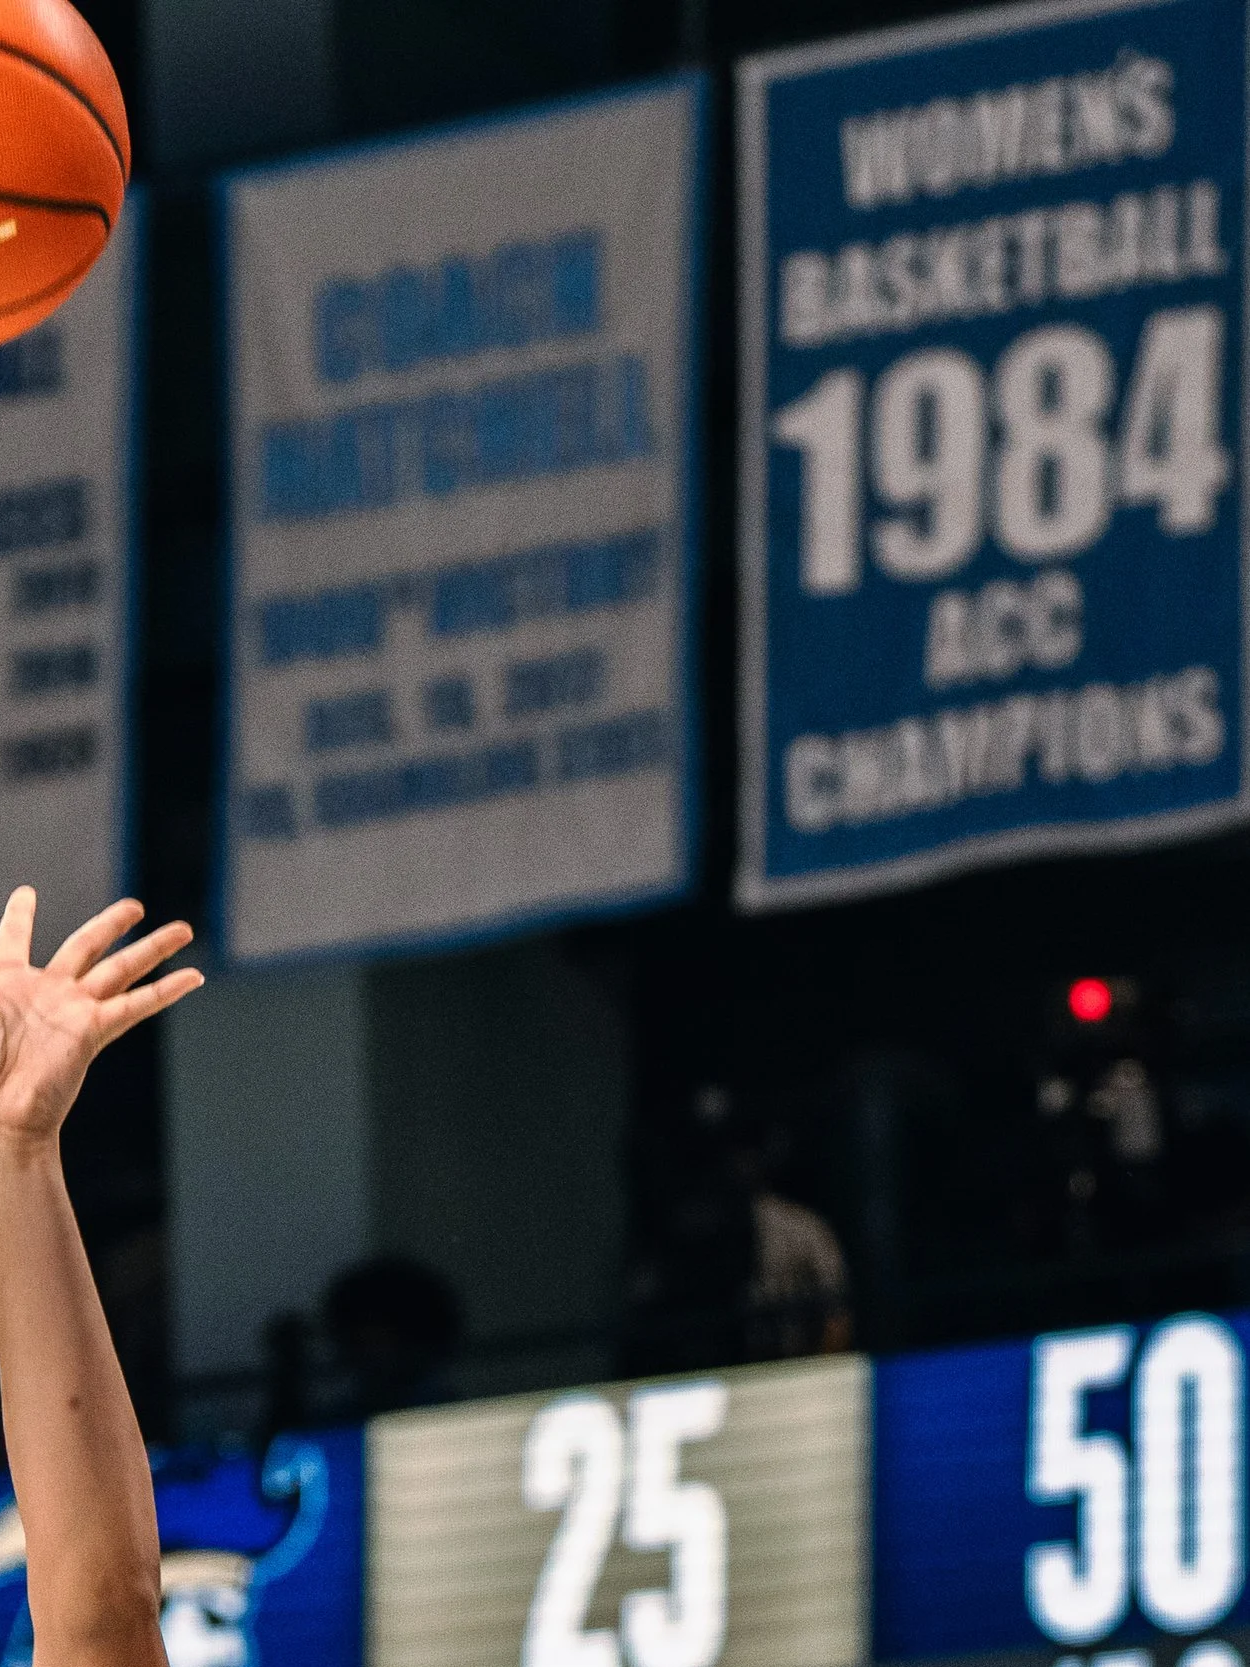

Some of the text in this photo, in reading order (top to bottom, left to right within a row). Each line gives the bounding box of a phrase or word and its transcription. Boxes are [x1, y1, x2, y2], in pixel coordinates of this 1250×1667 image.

[780, 178, 1228, 350] BASKETBALL
[772, 302, 1230, 598] 1984
[922, 568, 1085, 690] ACC
[784, 663, 1226, 835] CHAMPIONS
[1025, 1310, 1247, 1648] 50
